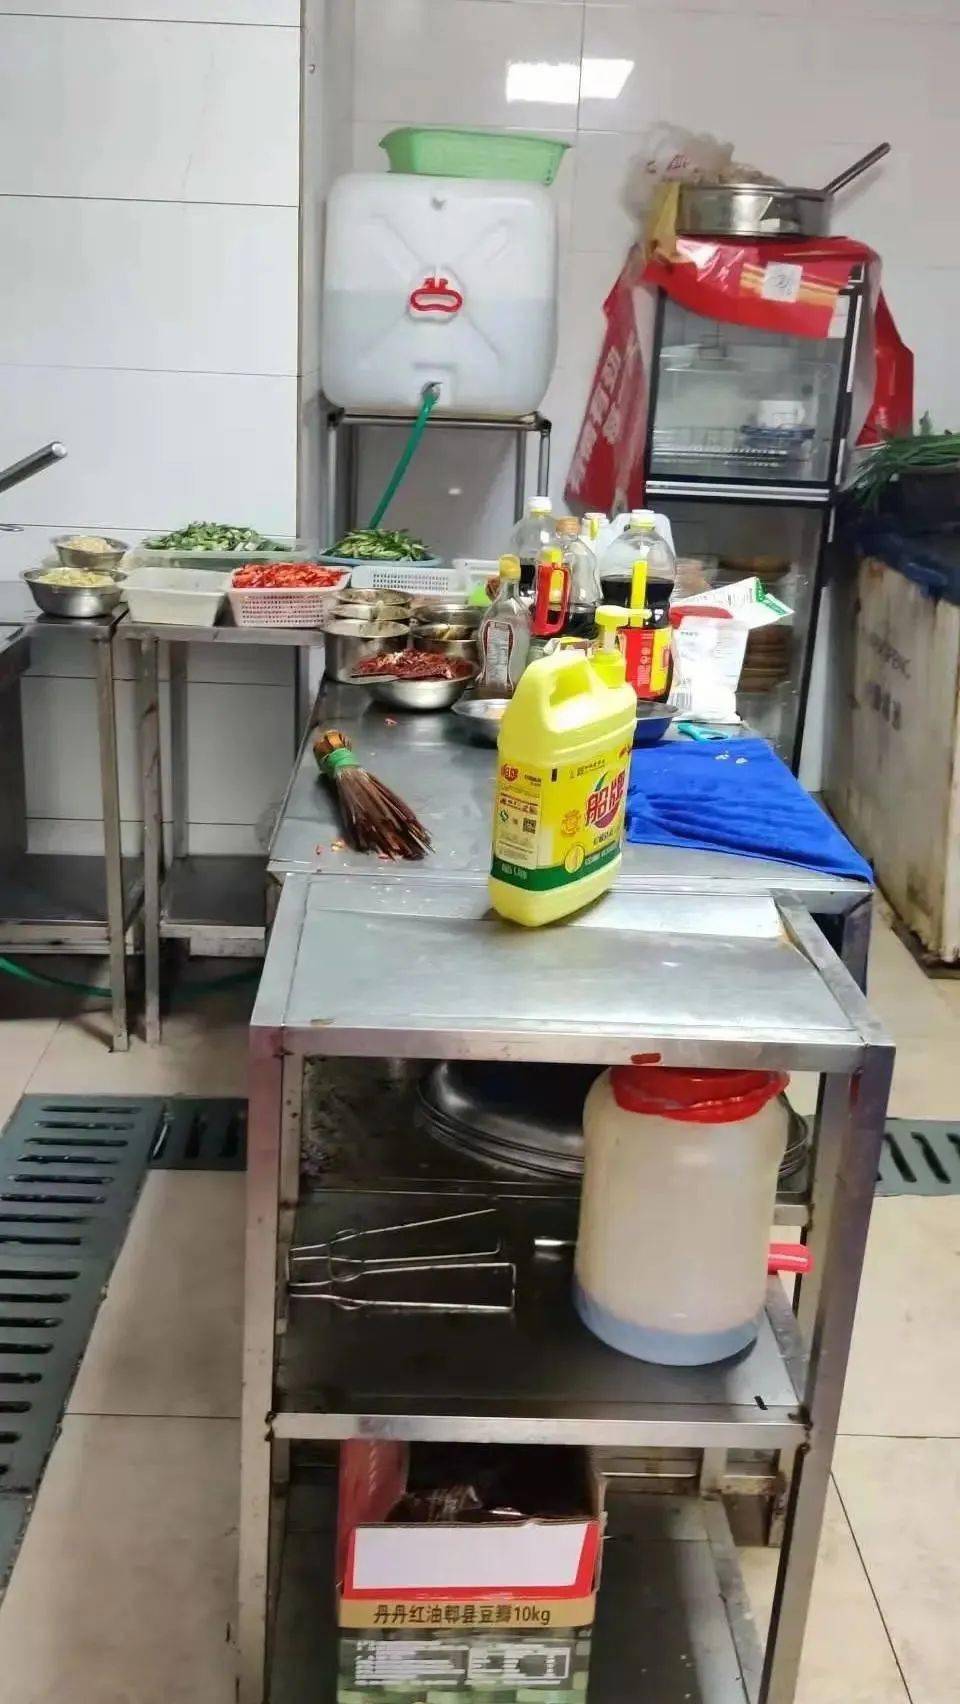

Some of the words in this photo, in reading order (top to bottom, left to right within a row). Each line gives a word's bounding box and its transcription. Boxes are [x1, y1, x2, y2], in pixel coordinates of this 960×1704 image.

[585, 770, 625, 826] 船牌
[373, 1604, 551, 1625] 丹丹红油郫县豆瓣10kg
